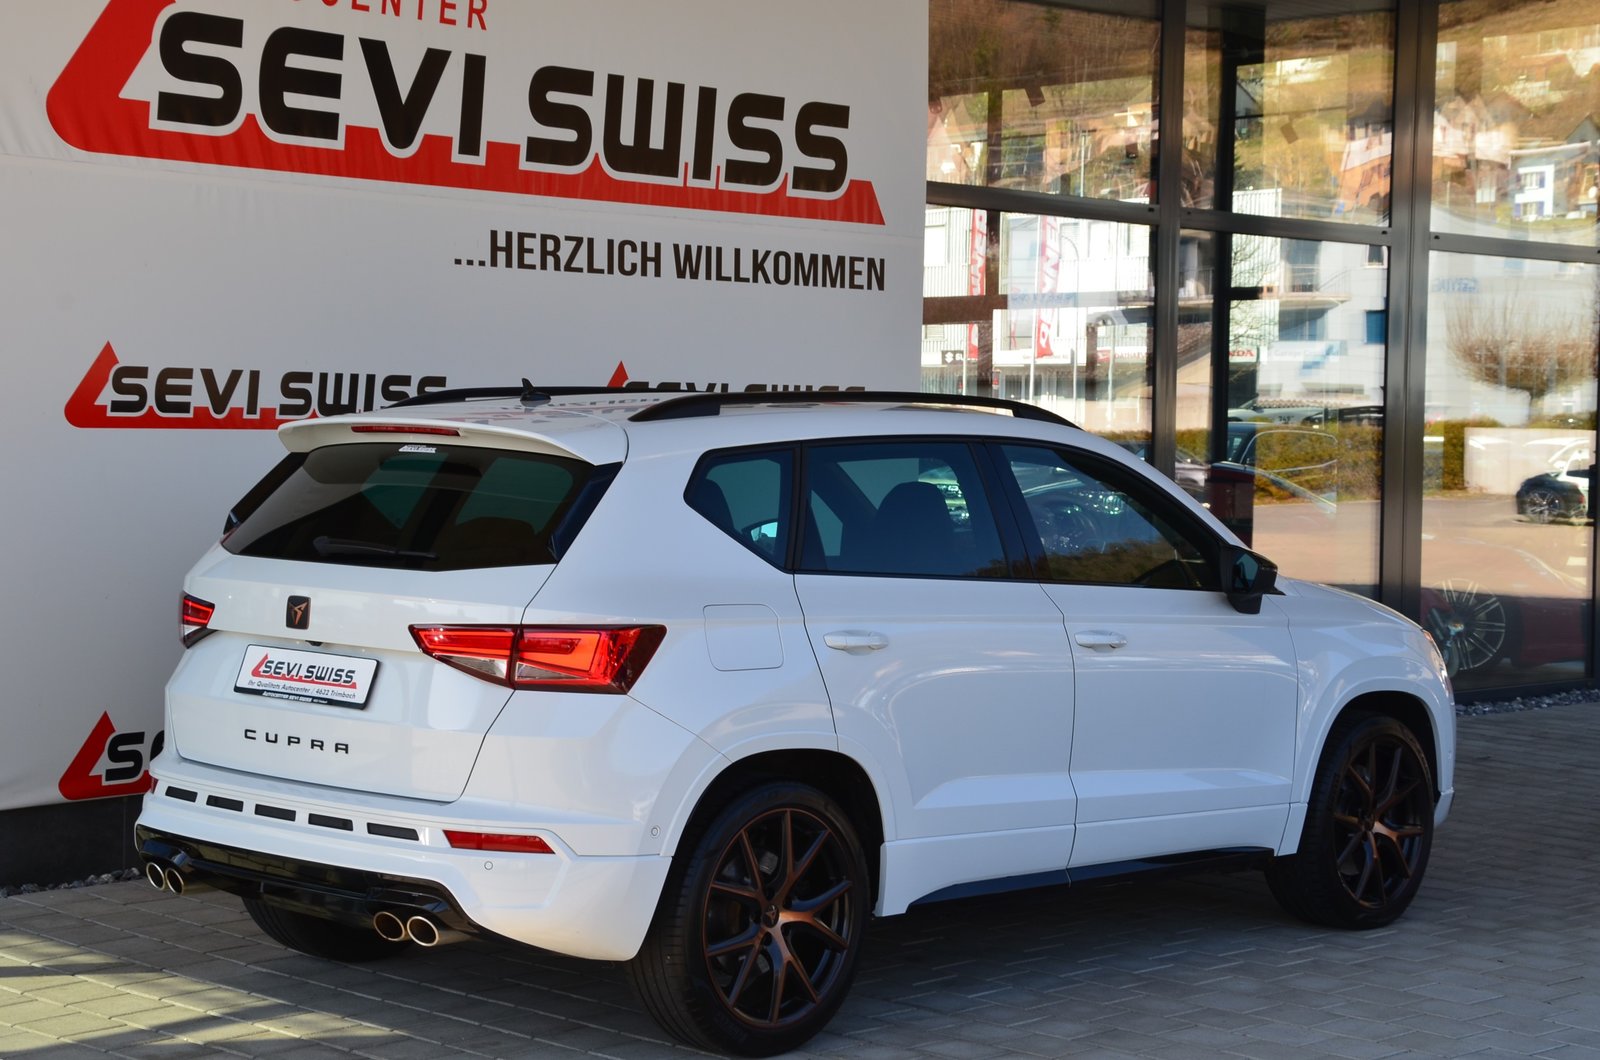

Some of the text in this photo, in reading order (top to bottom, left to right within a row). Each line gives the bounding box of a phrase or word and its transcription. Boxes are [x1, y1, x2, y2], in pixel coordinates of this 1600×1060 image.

[157, 11, 850, 193] SEVI SWISS
[454, 229, 886, 291] ...HERZLICH WILLKOMMEN
[107, 366, 260, 415] SEVI
[262, 660, 356, 684] SEVI SWISS
[244, 728, 349, 755] CUPRA
